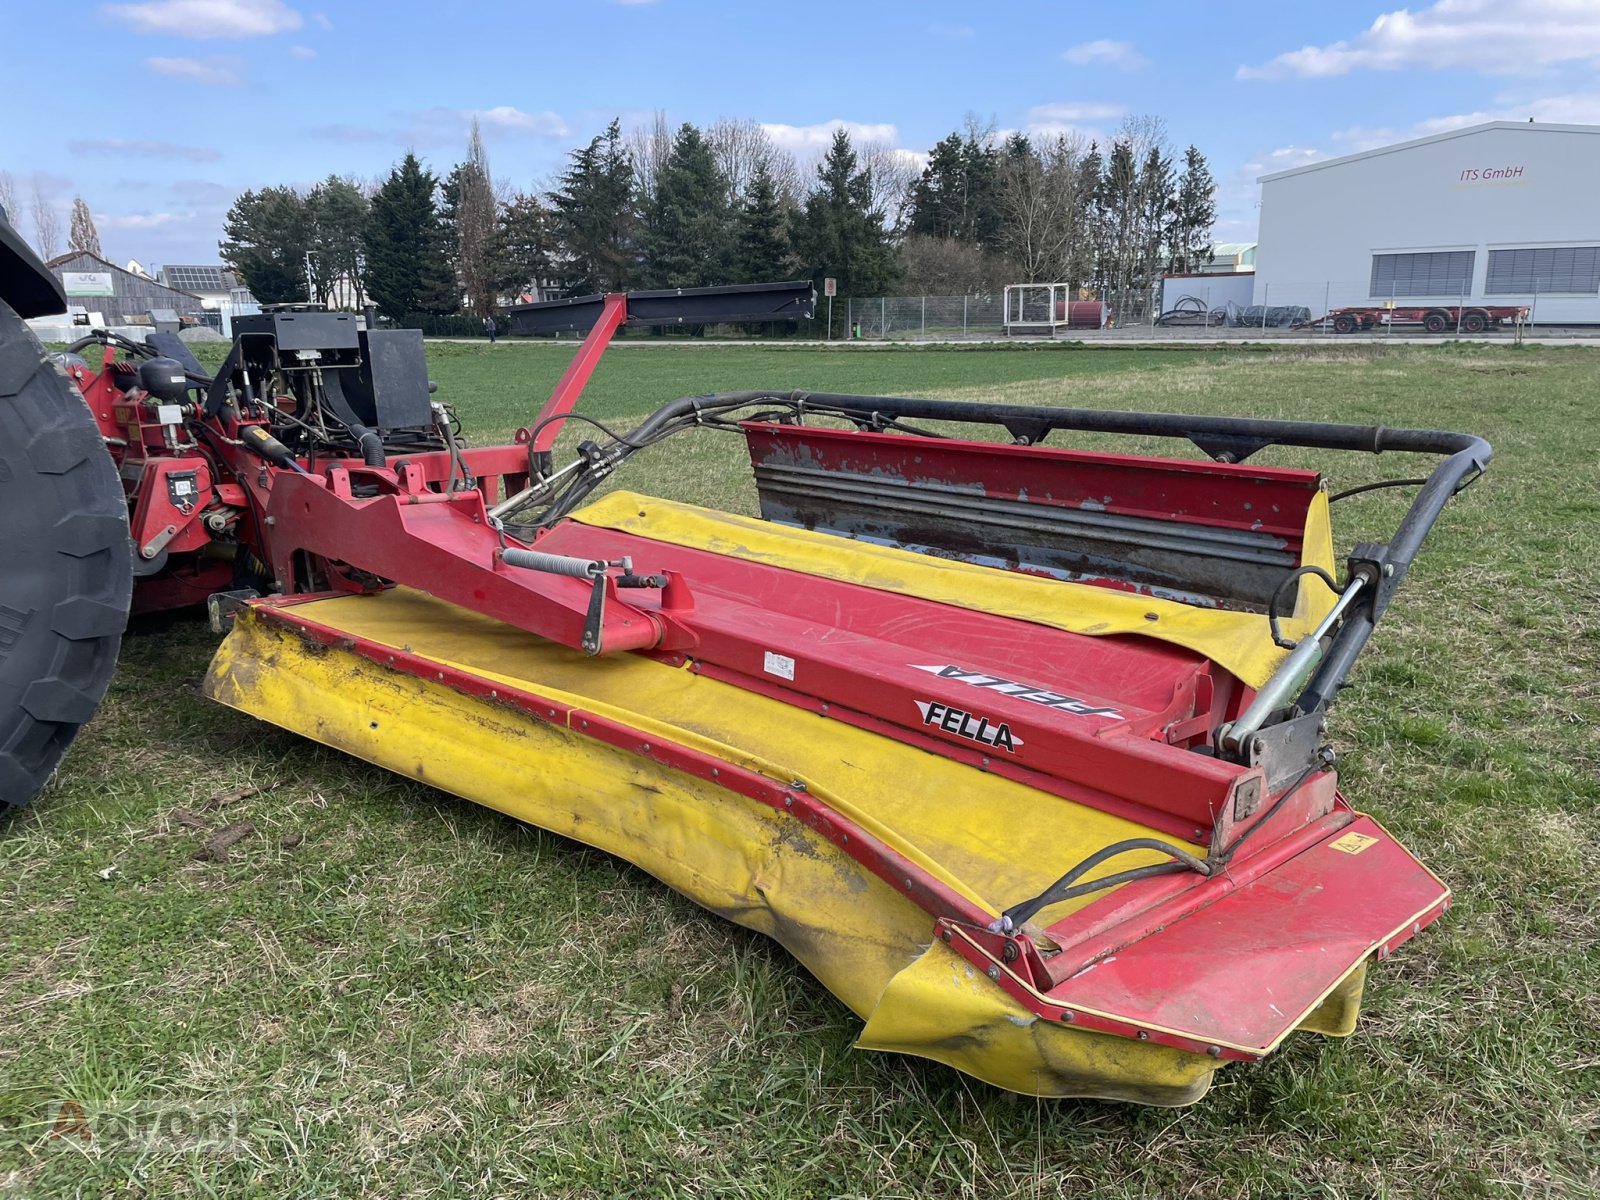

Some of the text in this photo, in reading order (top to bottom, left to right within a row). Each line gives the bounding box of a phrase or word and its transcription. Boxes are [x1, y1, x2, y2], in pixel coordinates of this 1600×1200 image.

[1460, 166, 1524, 181] ITS GmbH
[937, 665, 1121, 715] FELLA
[924, 701, 1015, 753] FELLA
